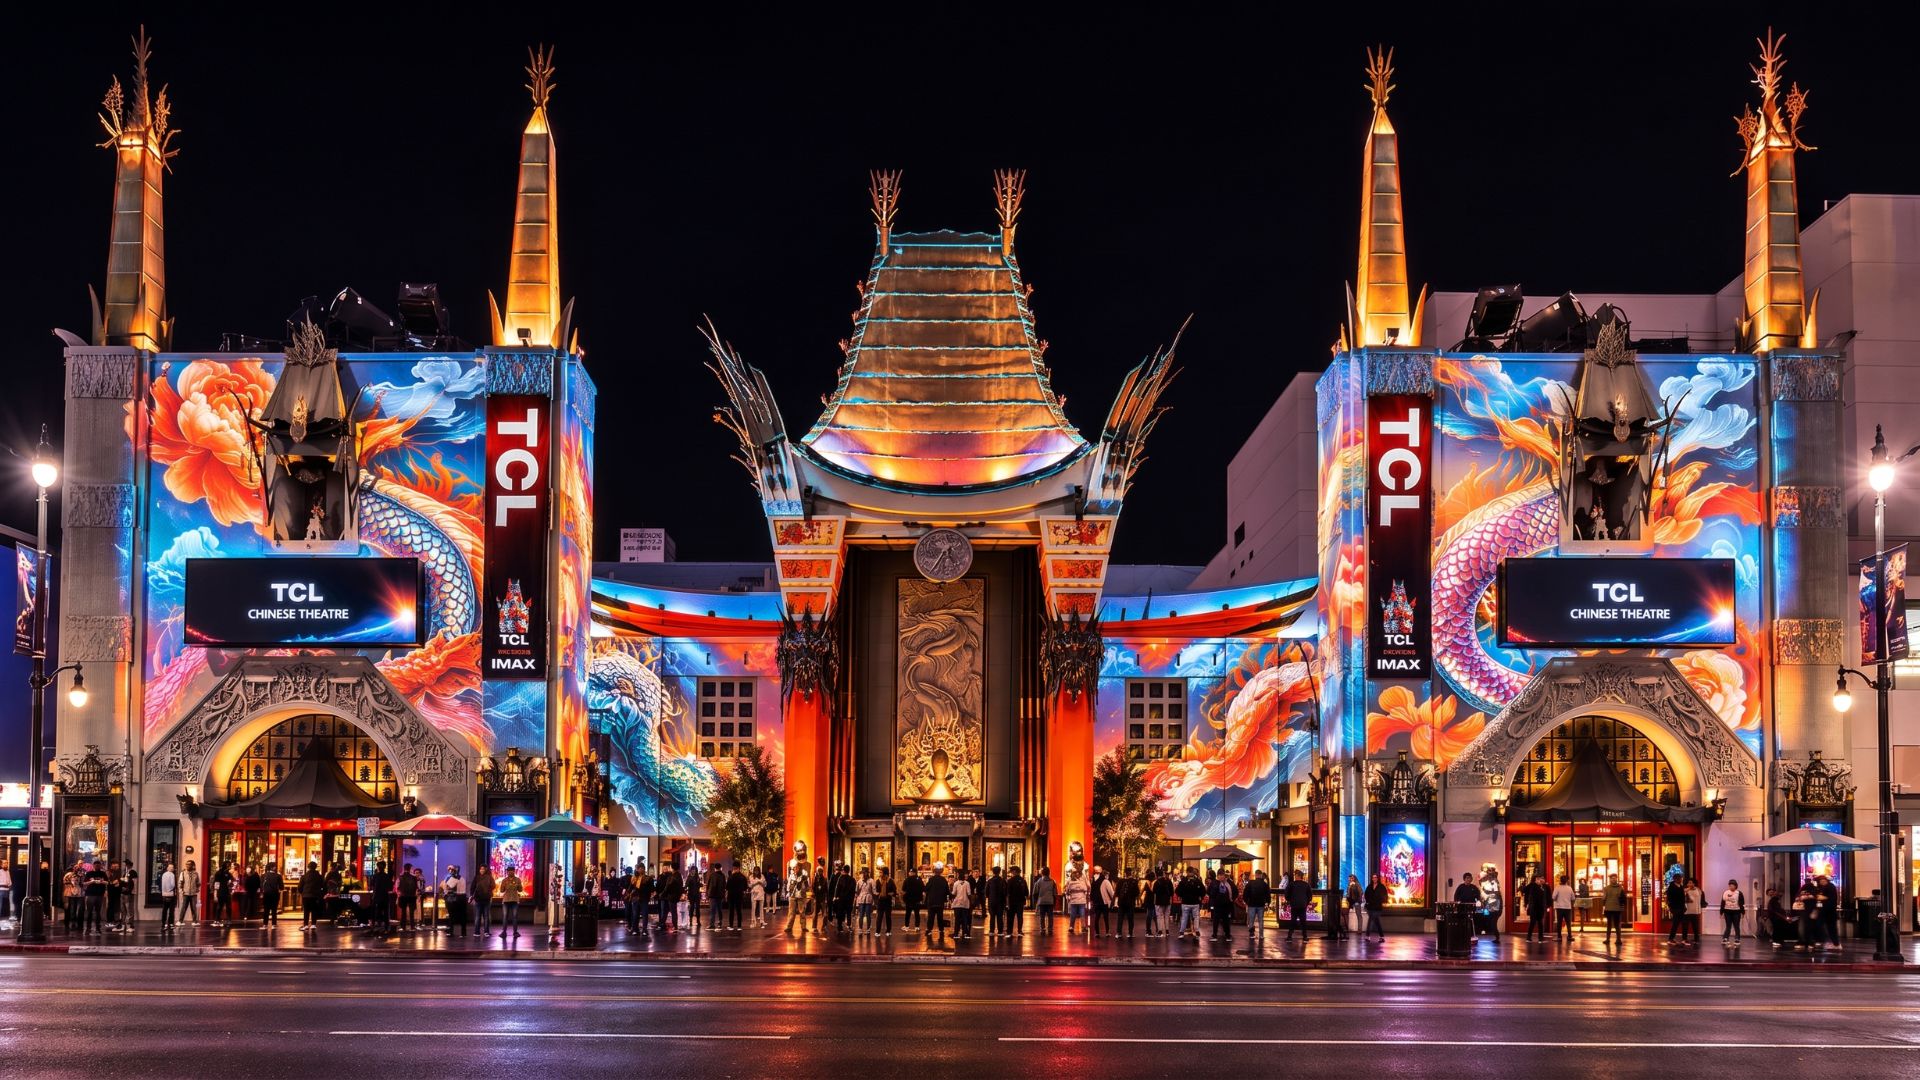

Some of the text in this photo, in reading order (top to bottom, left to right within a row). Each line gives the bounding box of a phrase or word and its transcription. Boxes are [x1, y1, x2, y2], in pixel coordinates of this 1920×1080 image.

[495, 408, 539, 527] TCL
[1378, 408, 1422, 527] TCL
[270, 583, 324, 602] TCL
[1592, 583, 1644, 602] TCL
[248, 608, 349, 619] CHINESE THEATRE
[1570, 608, 1671, 619] CHINESE THEATRE
[499, 634, 530, 646] TCL
[1384, 634, 1415, 646] TCL
[491, 658, 536, 670] IMAX
[1376, 658, 1421, 670] IMAX
